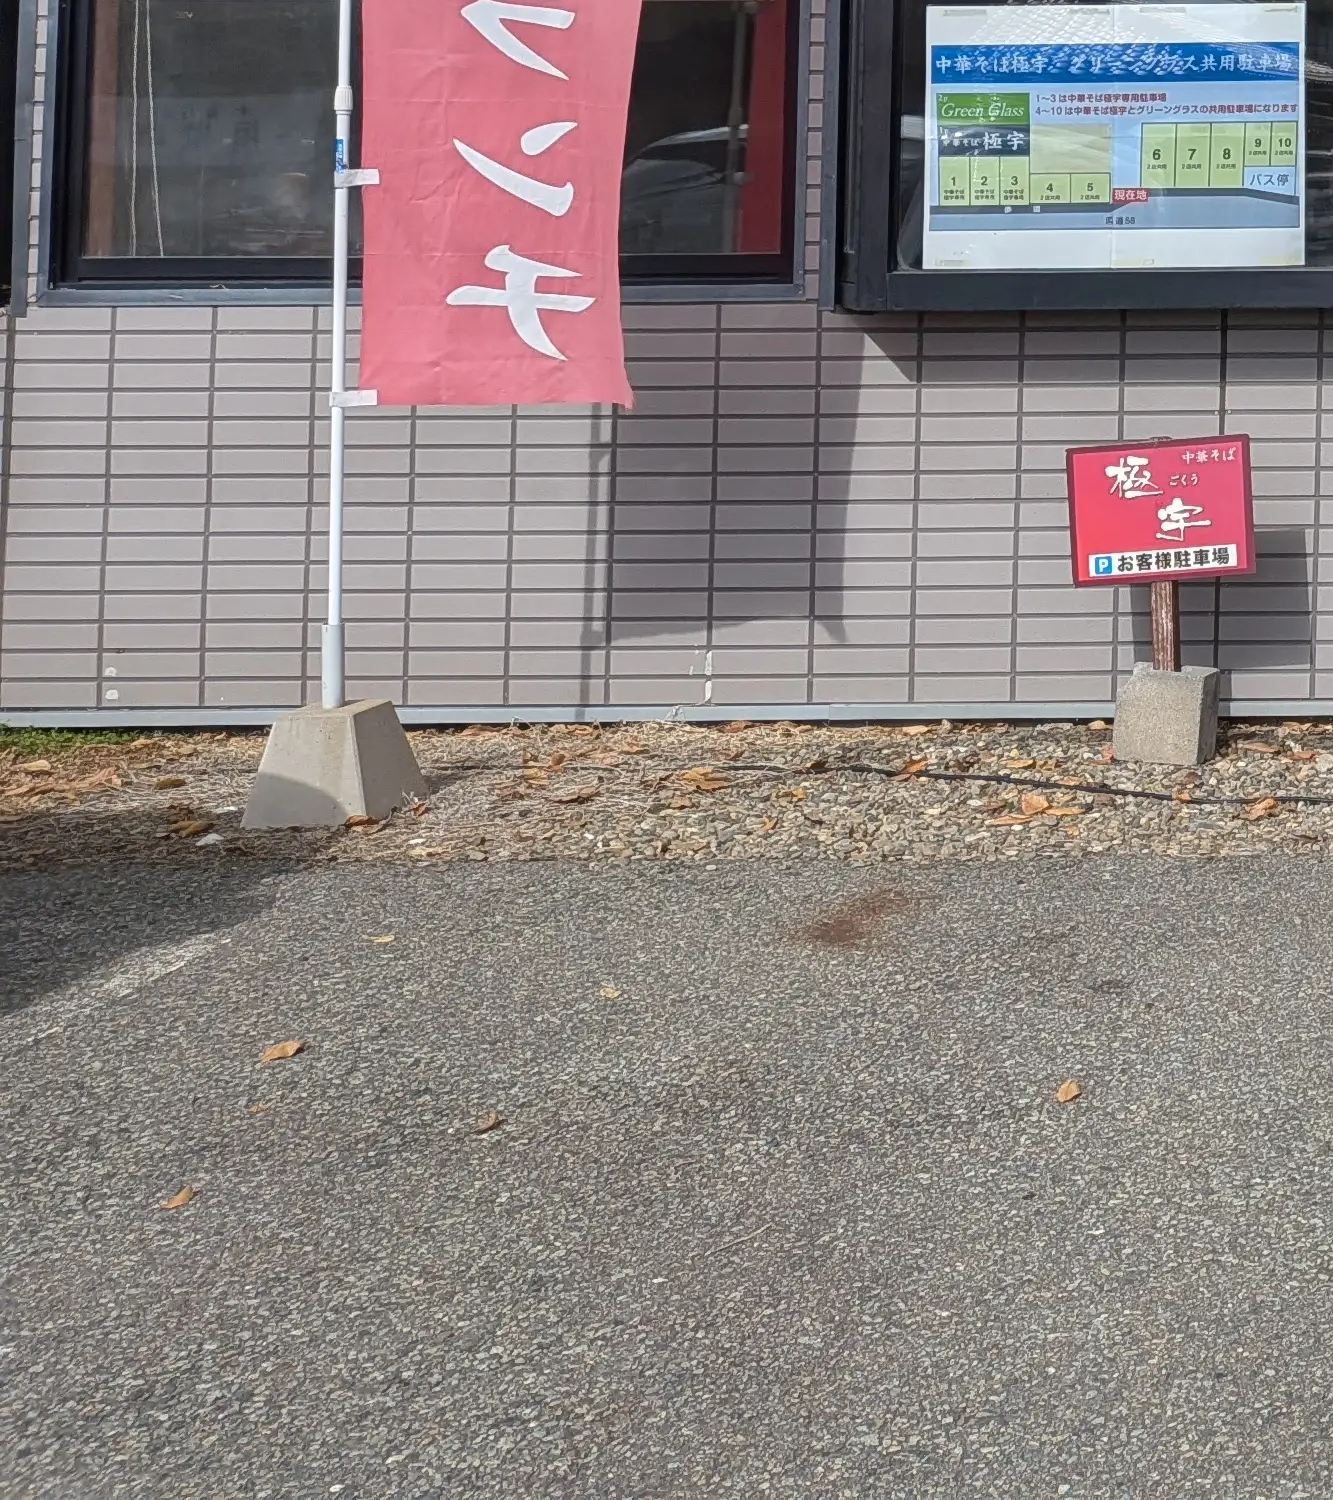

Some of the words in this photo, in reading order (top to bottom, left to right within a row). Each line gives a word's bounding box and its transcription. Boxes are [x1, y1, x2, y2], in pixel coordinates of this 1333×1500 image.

[941, 103, 984, 117] Green
[983, 131, 1025, 150] 極宇
[1254, 138, 1262, 148] 9
[1278, 138, 1292, 147] 10
[1152, 149, 1161, 161] 6
[1188, 149, 1197, 160] 7
[1222, 148, 1231, 160] 8
[950, 176, 956, 186] 1
[980, 176, 988, 186] 2
[1010, 176, 1019, 186] 3
[1250, 173, 1290, 187] バス停
[1045, 183, 1054, 192] 4
[1086, 182, 1094, 192] 5
[1114, 190, 1147, 200] 現在地
[1182, 447, 1236, 465] 中華そば
[1169, 473, 1199, 487] ごくう
[1117, 547, 1230, 573] お客様駐車場
